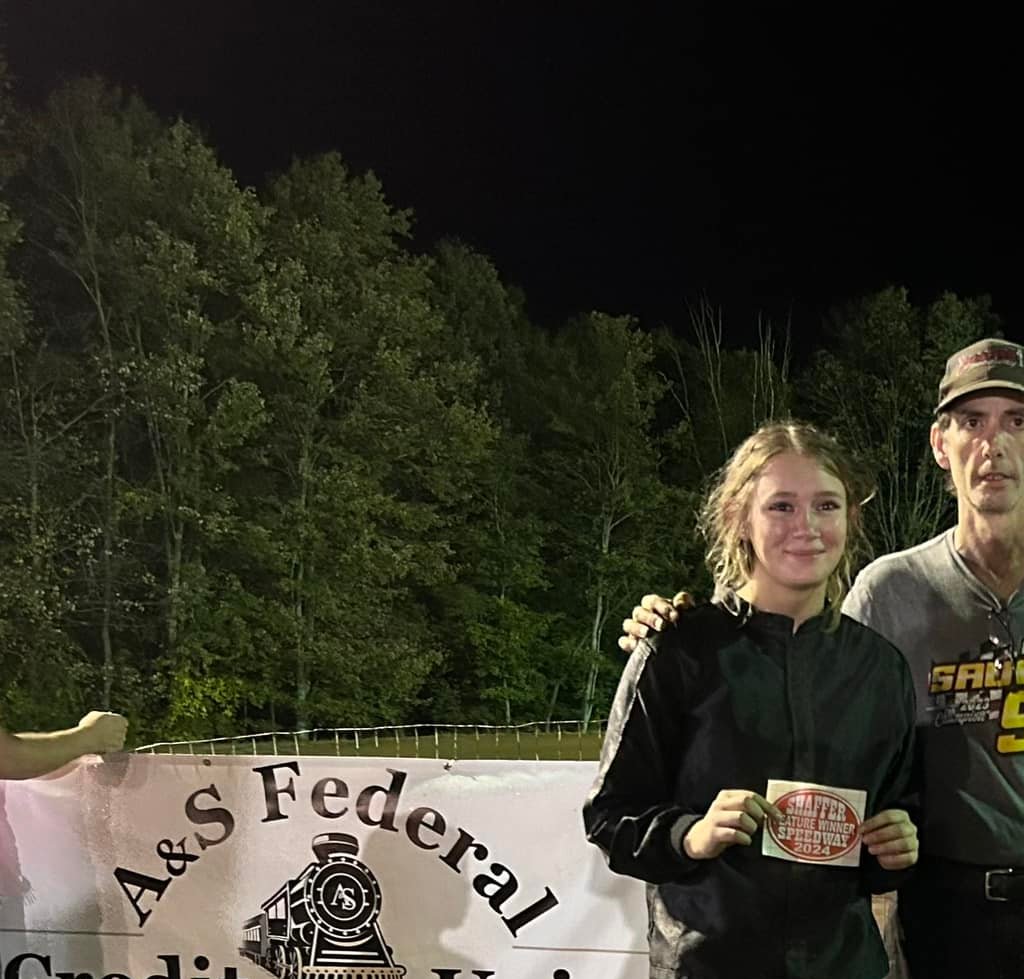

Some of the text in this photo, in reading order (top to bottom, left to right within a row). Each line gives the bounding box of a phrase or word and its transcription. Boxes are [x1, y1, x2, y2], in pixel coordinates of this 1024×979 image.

[786, 794, 847, 820] SHAFFER
[777, 815, 856, 835] EATURE WINNER
[778, 827, 850, 848] SPEEDWAY
[113, 761, 559, 938] A&S Federal
[794, 842, 831, 856] 2024
